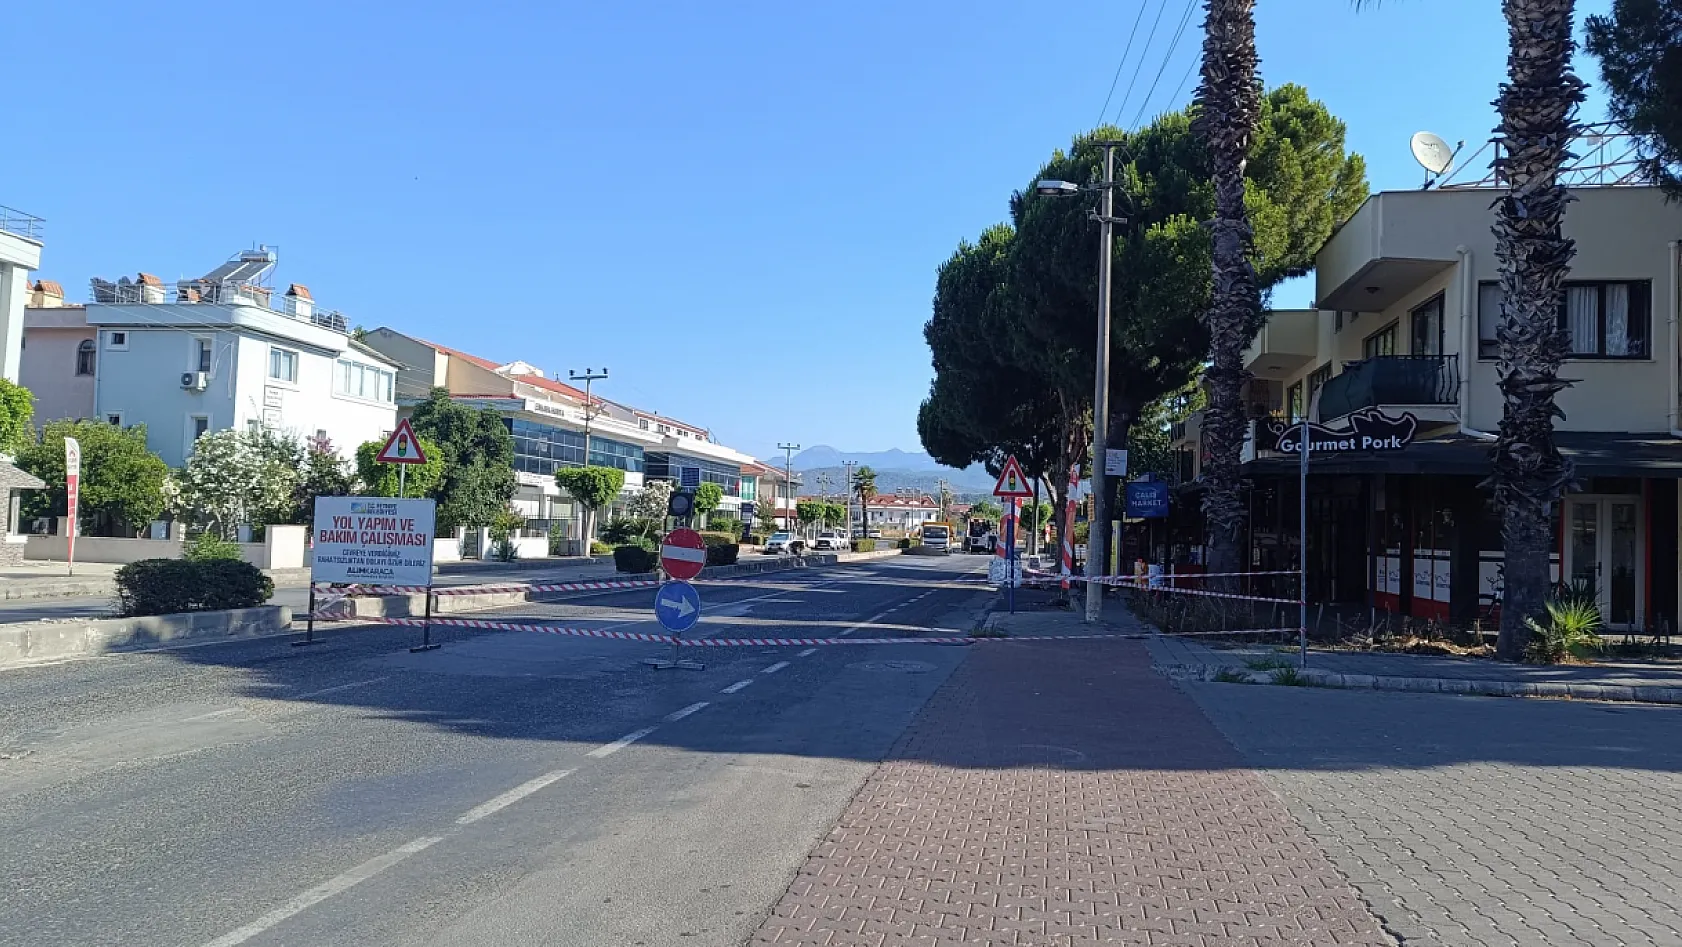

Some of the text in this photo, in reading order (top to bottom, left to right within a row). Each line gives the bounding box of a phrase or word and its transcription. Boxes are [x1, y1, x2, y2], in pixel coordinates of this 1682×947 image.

[1280, 435, 1401, 452] Gourmet Pork
[332, 515, 414, 532] YOL YAPIM VE
[319, 529, 427, 548] BAKIM ÇALIŞMASI
